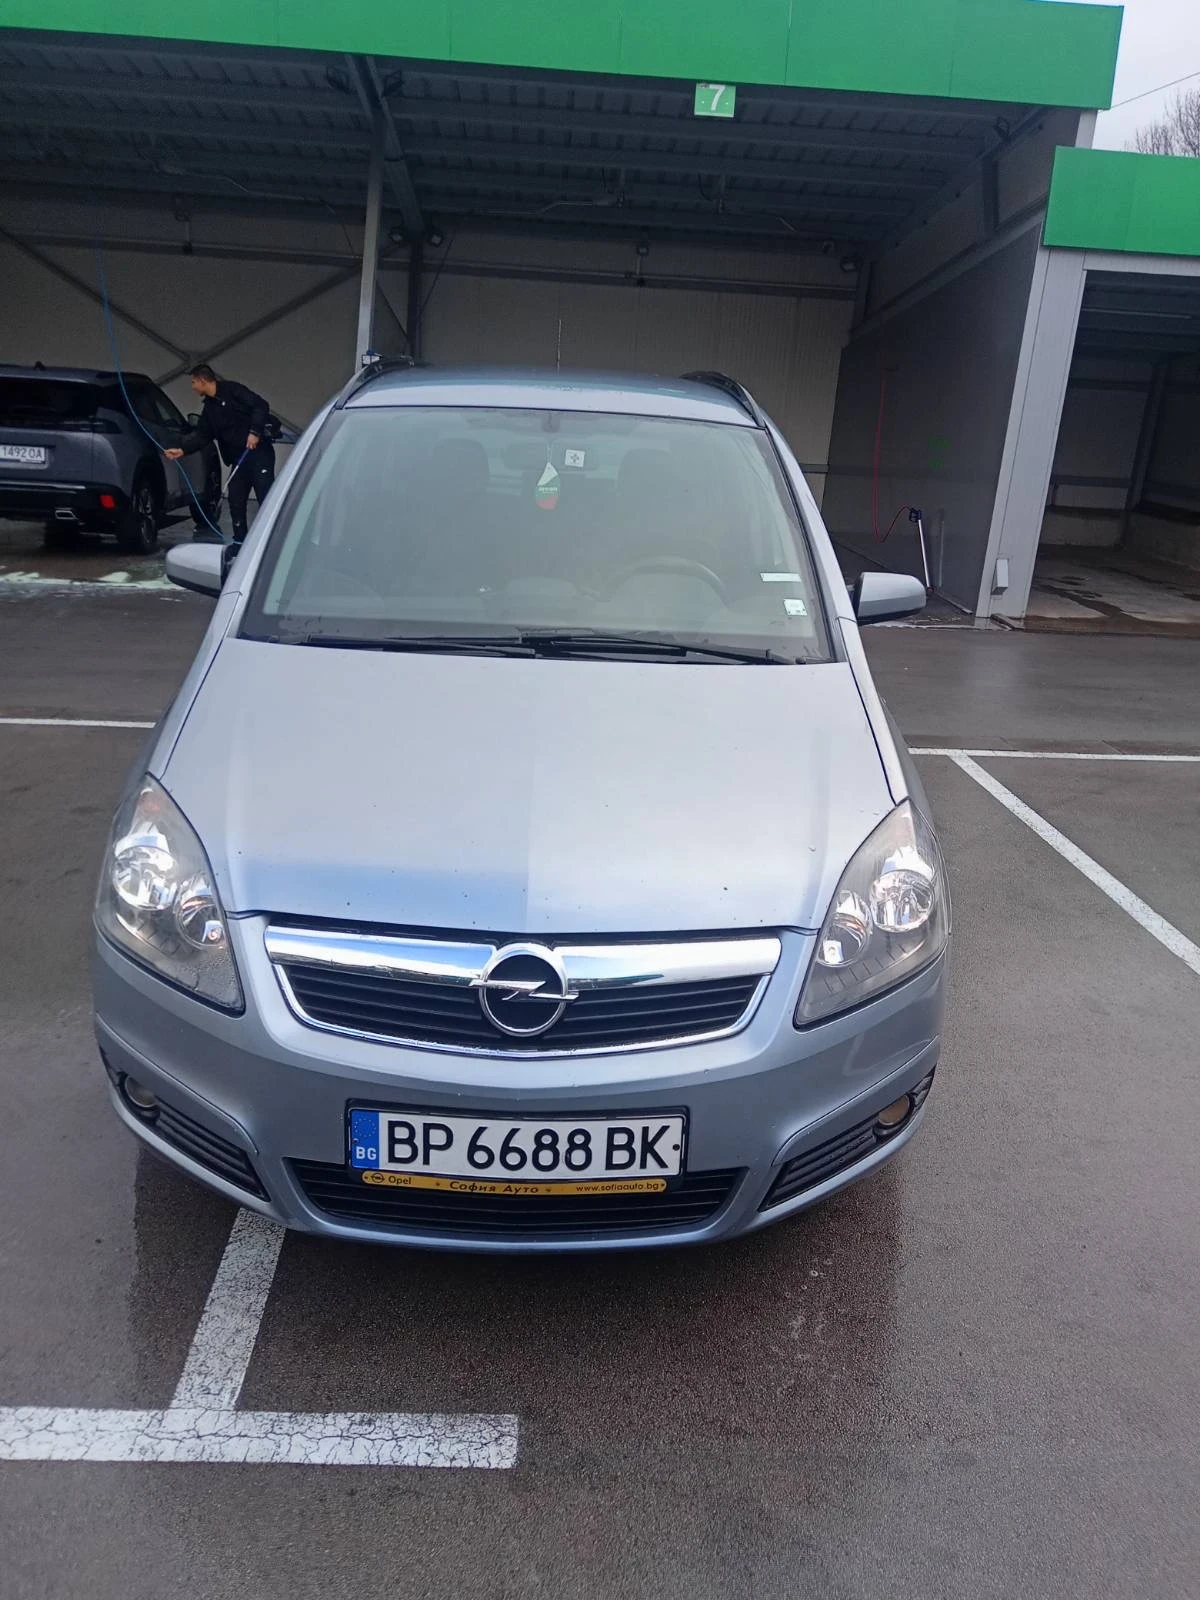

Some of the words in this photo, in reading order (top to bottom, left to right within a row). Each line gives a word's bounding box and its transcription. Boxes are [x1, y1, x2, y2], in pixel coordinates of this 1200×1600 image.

[709, 84, 726, 111] 7
[356, 1146, 377, 1160] BG
[388, 1120, 454, 1165] BP
[467, 1126, 592, 1172] 6688
[605, 1125, 670, 1170] BK
[388, 1175, 412, 1186] Opel
[576, 1183, 659, 1192] www.sofiaauto.bg
[450, 1181, 496, 1193] София
[503, 1184, 539, 1195] Ауто
